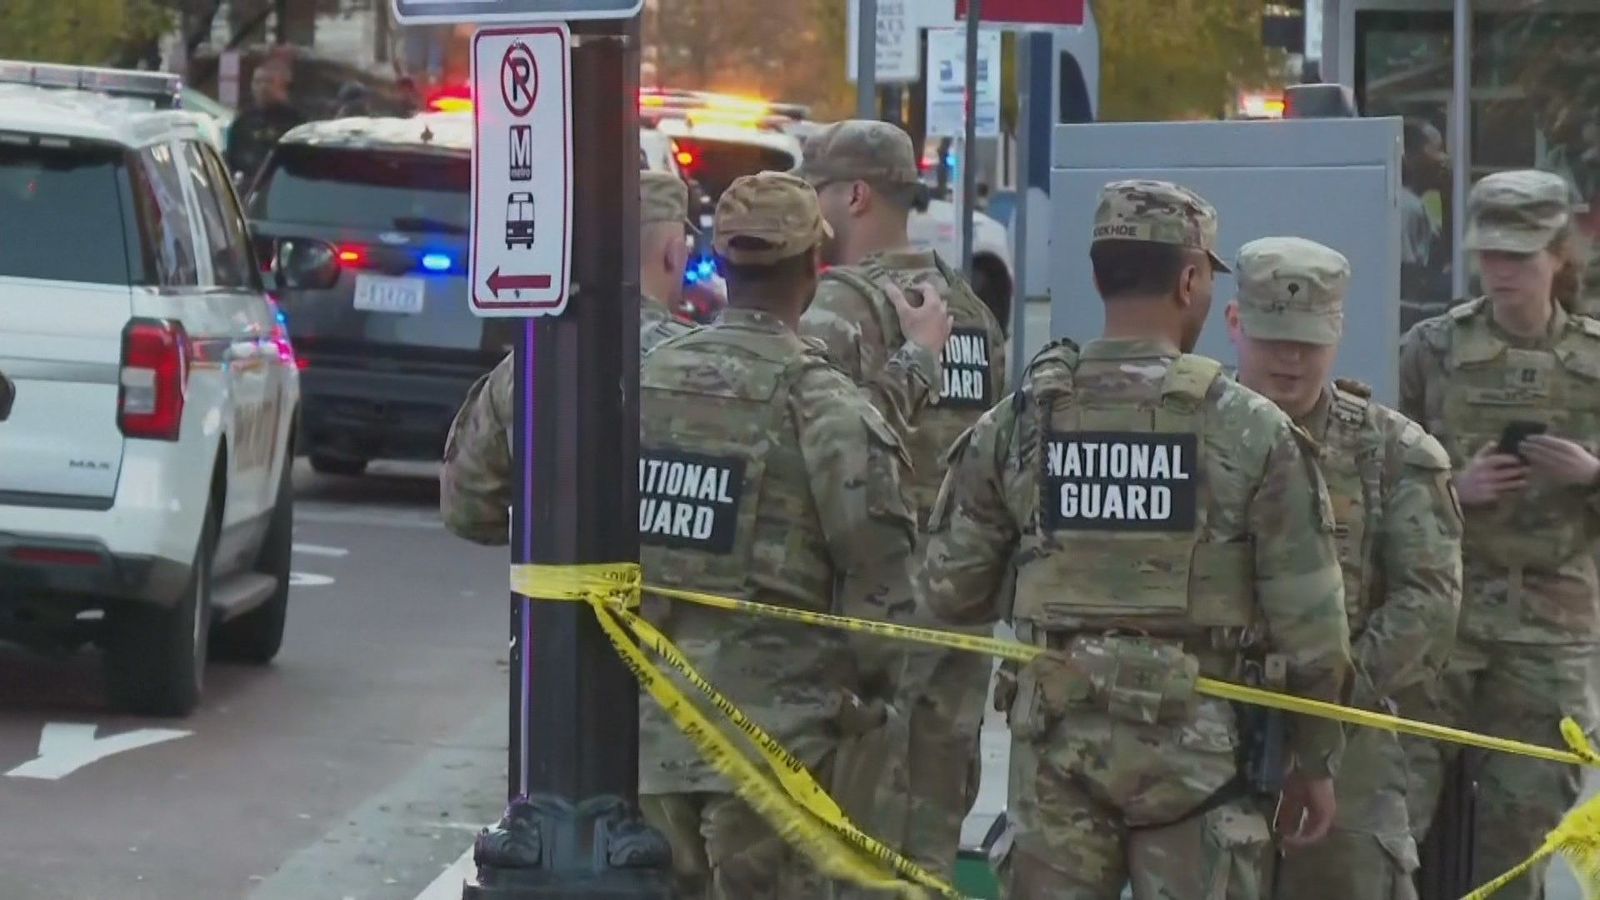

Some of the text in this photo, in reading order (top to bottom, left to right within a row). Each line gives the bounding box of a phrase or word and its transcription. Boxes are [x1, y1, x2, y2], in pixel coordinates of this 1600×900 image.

[510, 127, 531, 168] M
[940, 334, 988, 366] IONAL
[639, 458, 734, 503] TIONAL
[1047, 441, 1189, 480] NATIONAL
[639, 498, 715, 540] UARD
[1060, 482, 1172, 520] GUARD
